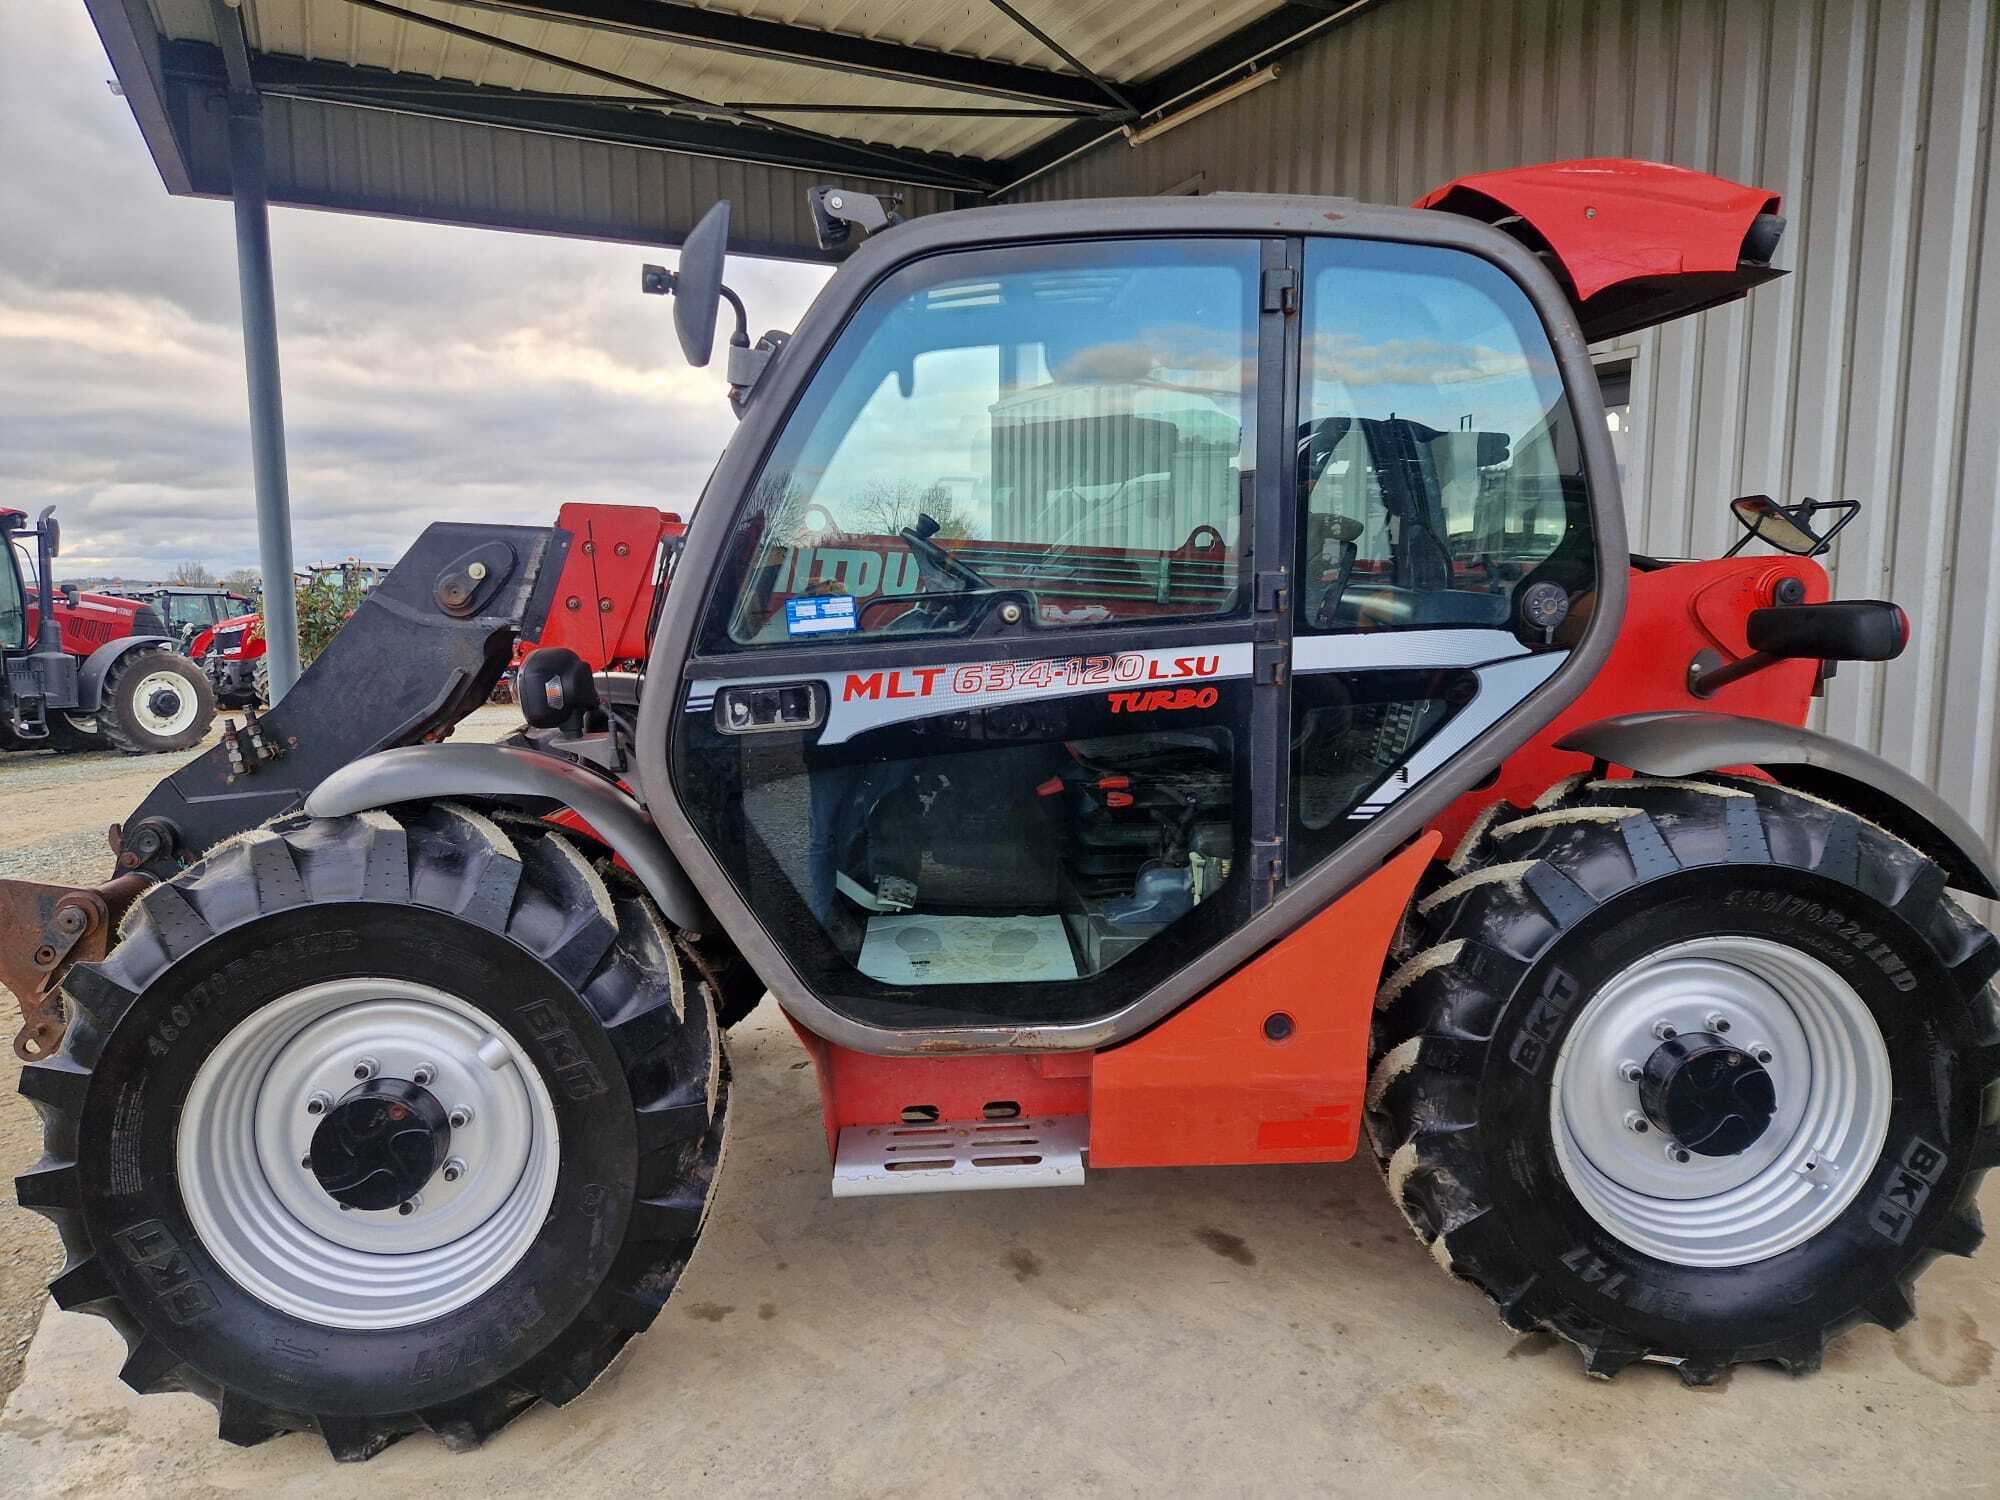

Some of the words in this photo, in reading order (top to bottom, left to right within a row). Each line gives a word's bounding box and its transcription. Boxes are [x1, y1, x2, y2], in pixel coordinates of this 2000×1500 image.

[843, 669, 945, 701] MLT
[953, 654, 1144, 694] 634-120
[1148, 656, 1220, 680] LSU
[1107, 687, 1218, 713] TURBO
[1509, 965, 1580, 1076] BKT
[1868, 1136, 1949, 1247] BKT
